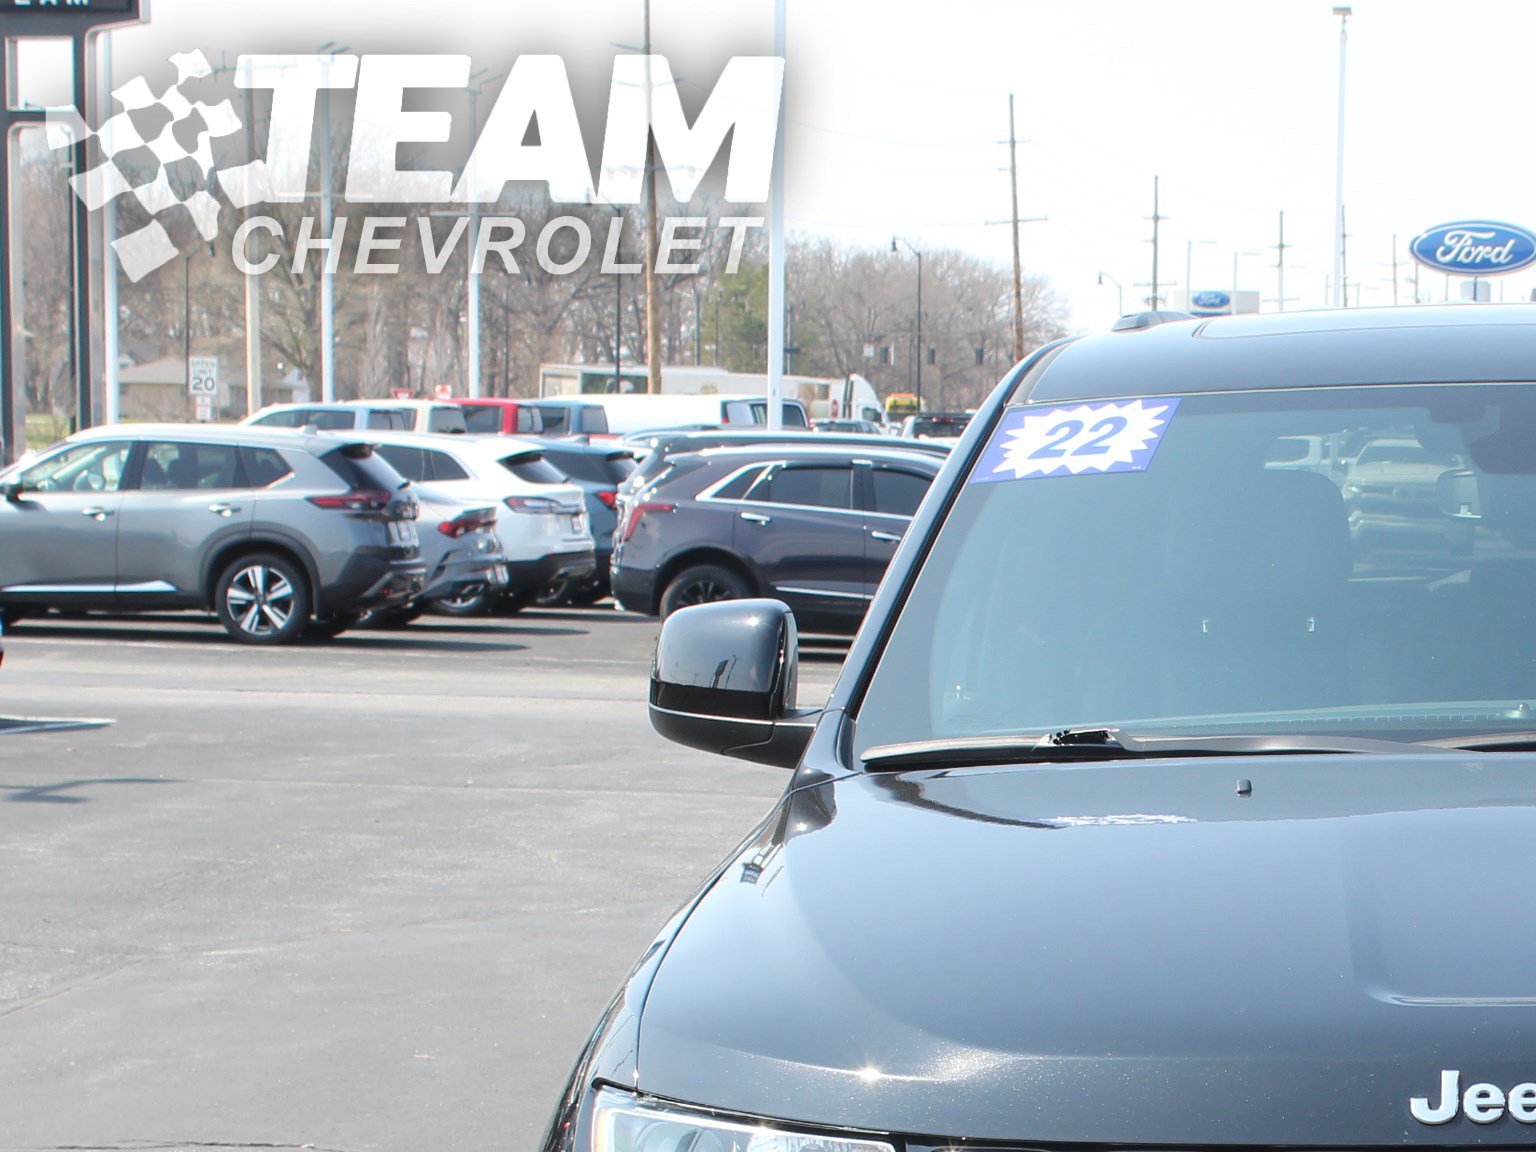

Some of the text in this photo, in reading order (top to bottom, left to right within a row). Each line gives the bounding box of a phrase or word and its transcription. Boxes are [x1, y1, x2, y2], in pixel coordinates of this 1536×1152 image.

[1436, 230, 1516, 264] Ford
[192, 376, 216, 392] 20
[1026, 416, 1128, 460] 22
